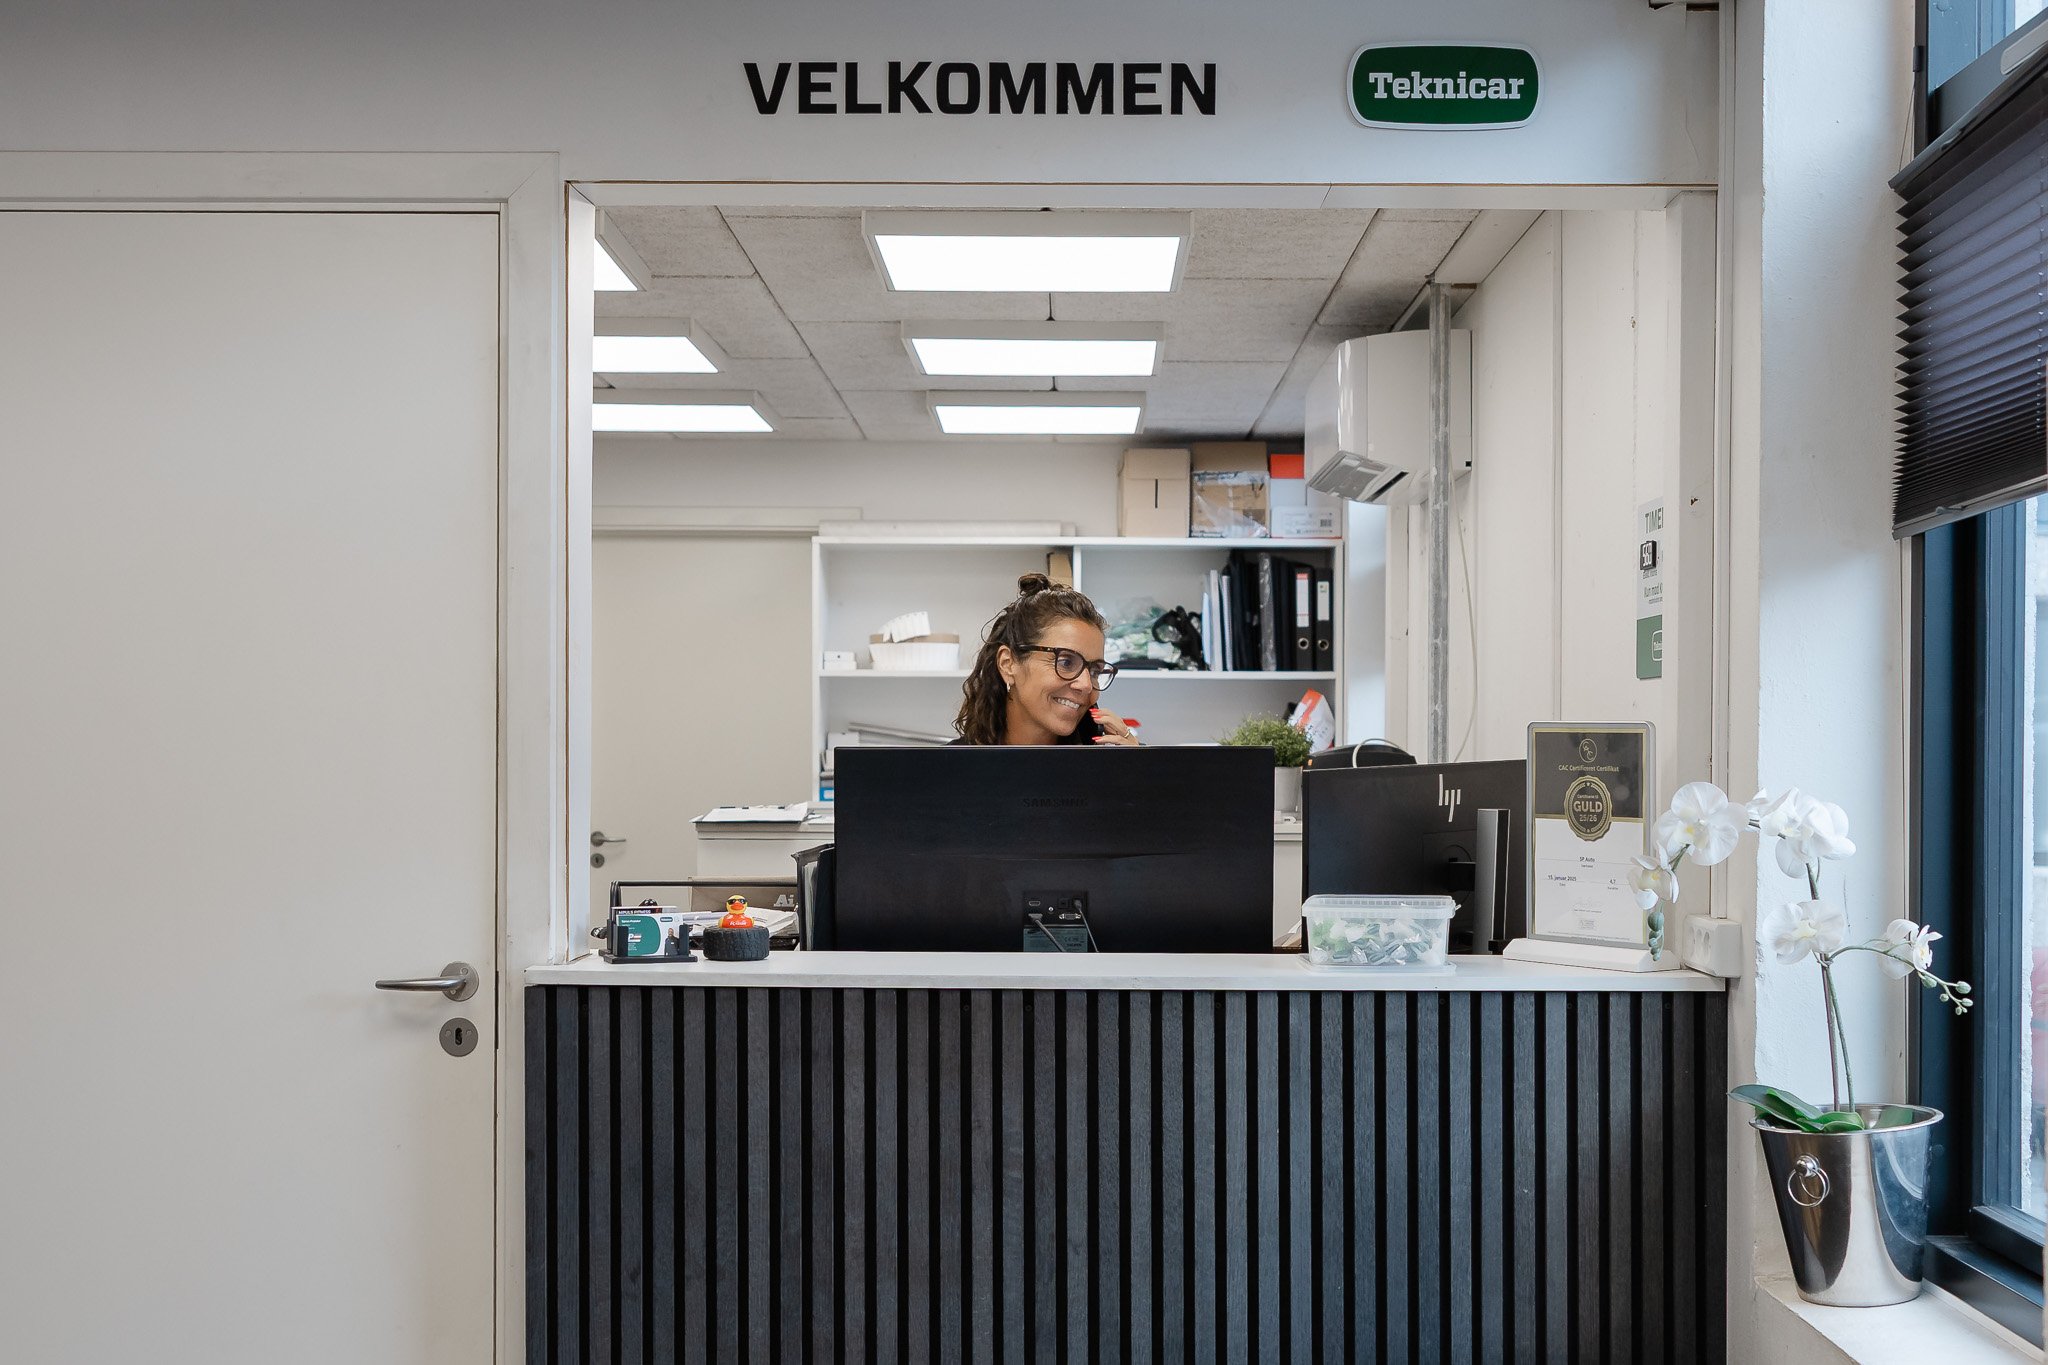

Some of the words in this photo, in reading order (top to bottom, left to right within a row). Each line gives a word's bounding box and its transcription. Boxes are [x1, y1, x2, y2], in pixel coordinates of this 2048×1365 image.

[743, 62, 1217, 115] VELKOMMEN
[1368, 71, 1525, 100] Teknicar
[1645, 507, 1664, 534] TIME
[1438, 773, 1461, 823] hp
[1573, 800, 1603, 813] GULD
[1579, 814, 1598, 822] 25/26
